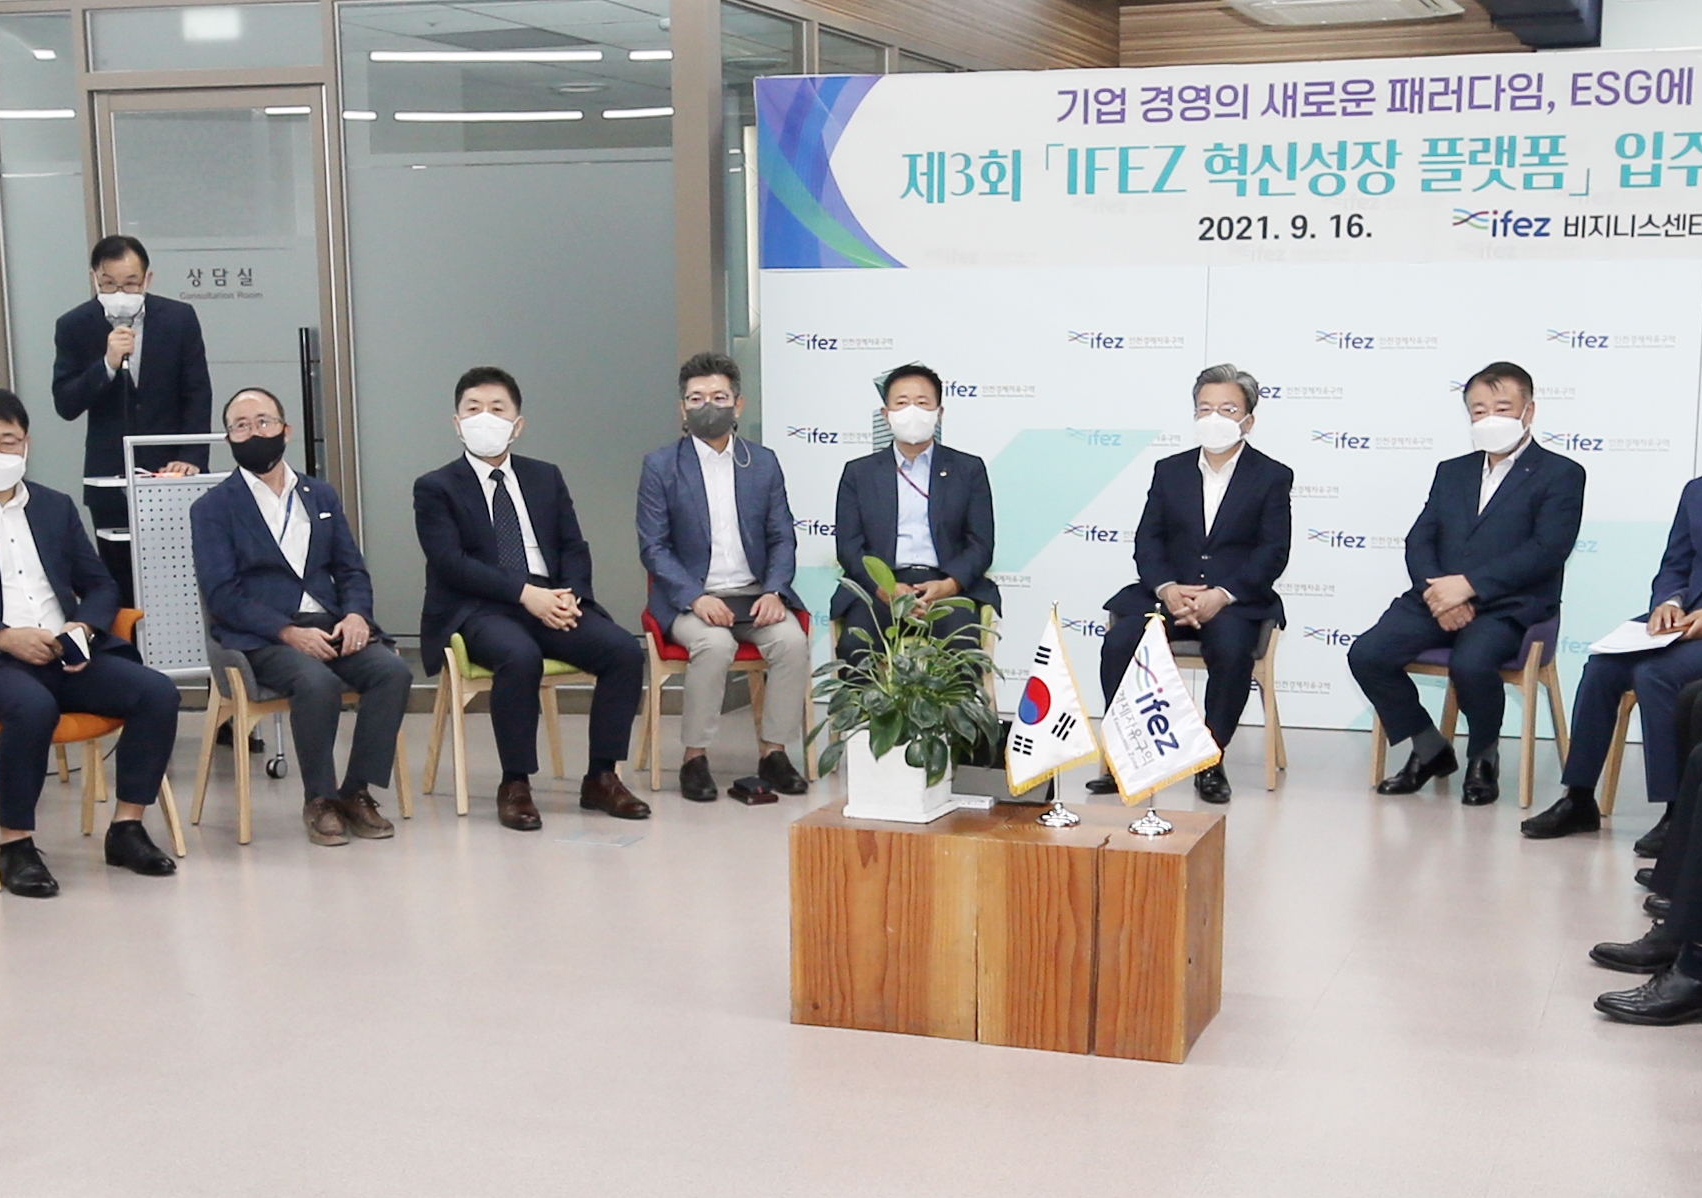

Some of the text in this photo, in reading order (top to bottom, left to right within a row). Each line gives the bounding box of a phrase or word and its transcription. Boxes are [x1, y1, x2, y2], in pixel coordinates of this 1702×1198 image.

[1055, 87, 1127, 125] 기업
[1139, 82, 1252, 123] 경영의
[1261, 78, 1377, 119] 새로운
[1387, 71, 1557, 115] 패러다임,
[1569, 66, 1693, 108] ESG에
[899, 149, 1023, 204] 제3회
[1045, 143, 1187, 197] 「IFEZ
[1202, 138, 1401, 199] 혁신성장
[1418, 133, 1591, 198] 플랫폼」
[1198, 212, 1373, 242] 2021. 9. 16.
[1490, 209, 1551, 238] ifez
[187, 268, 253, 288] 상담실
[179, 291, 263, 300] Consultation Room
[806, 333, 838, 350] ifez
[1090, 332, 1124, 349] ifez
[1339, 332, 1375, 349] ifez
[1571, 330, 1609, 349] ifez
[945, 381, 978, 397] ifez
[1258, 386, 1282, 399] ez
[807, 427, 839, 444] ifez
[1088, 430, 1122, 446] ifez
[1335, 432, 1371, 449] ifez
[1566, 433, 1604, 451] ifez
[1085, 525, 1119, 542] ifez
[1331, 530, 1366, 548] ifez
[1574, 540, 1598, 553] ez
[1083, 620, 1106, 637] ife
[1135, 687, 1179, 756] ifez
